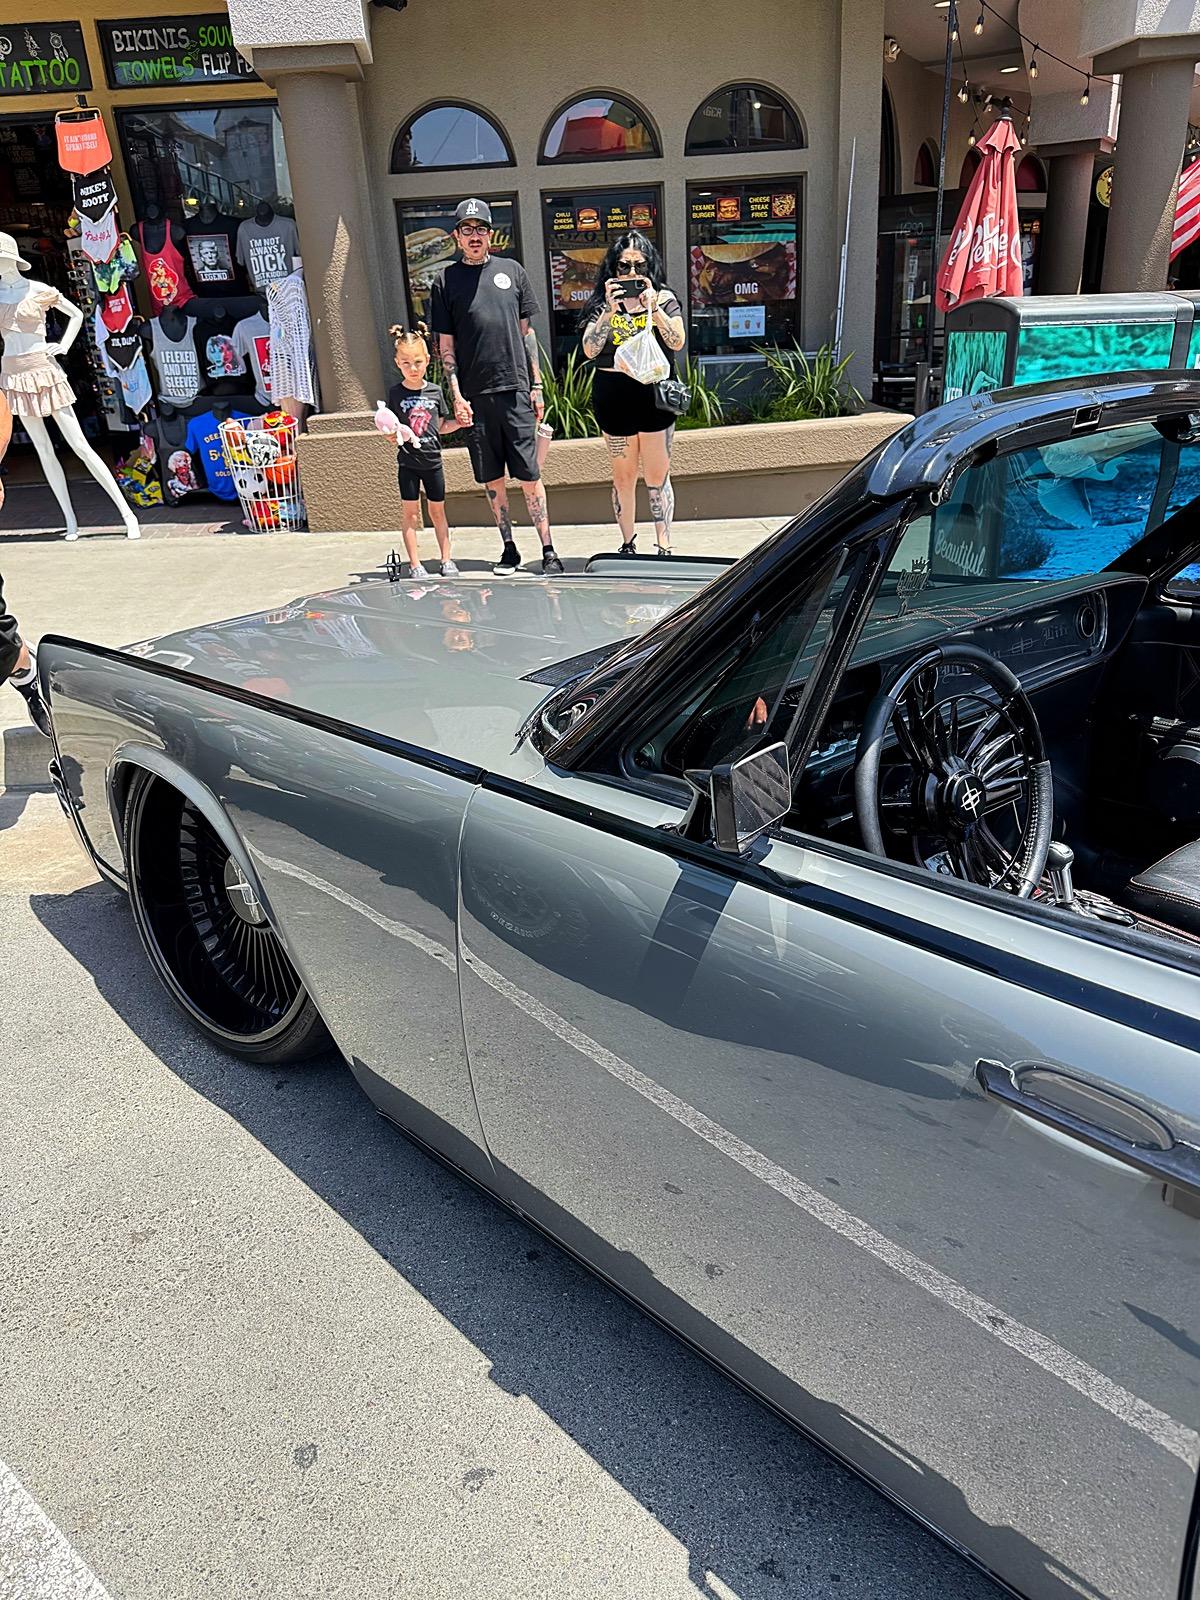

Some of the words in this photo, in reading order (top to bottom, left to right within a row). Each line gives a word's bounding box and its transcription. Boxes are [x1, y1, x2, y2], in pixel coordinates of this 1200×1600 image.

[112, 28, 190, 52] BIKINIS
[0, 57, 80, 88] TATTOO
[117, 56, 195, 81] TOWELS
[202, 52, 231, 75] FLIP
[82, 193, 110, 208] BOOTY
[263, 236, 280, 246] NOT
[250, 244, 278, 257] ALWAYS
[280, 244, 286, 253] A
[250, 253, 288, 275] DICK
[734, 282, 759, 294] OMG
[165, 351, 195, 363] FLEXED
[163, 364, 181, 376] AND
[181, 363, 197, 375] THE
[166, 376, 198, 388] SLEEVES
[935, 529, 986, 577] Beautiful
